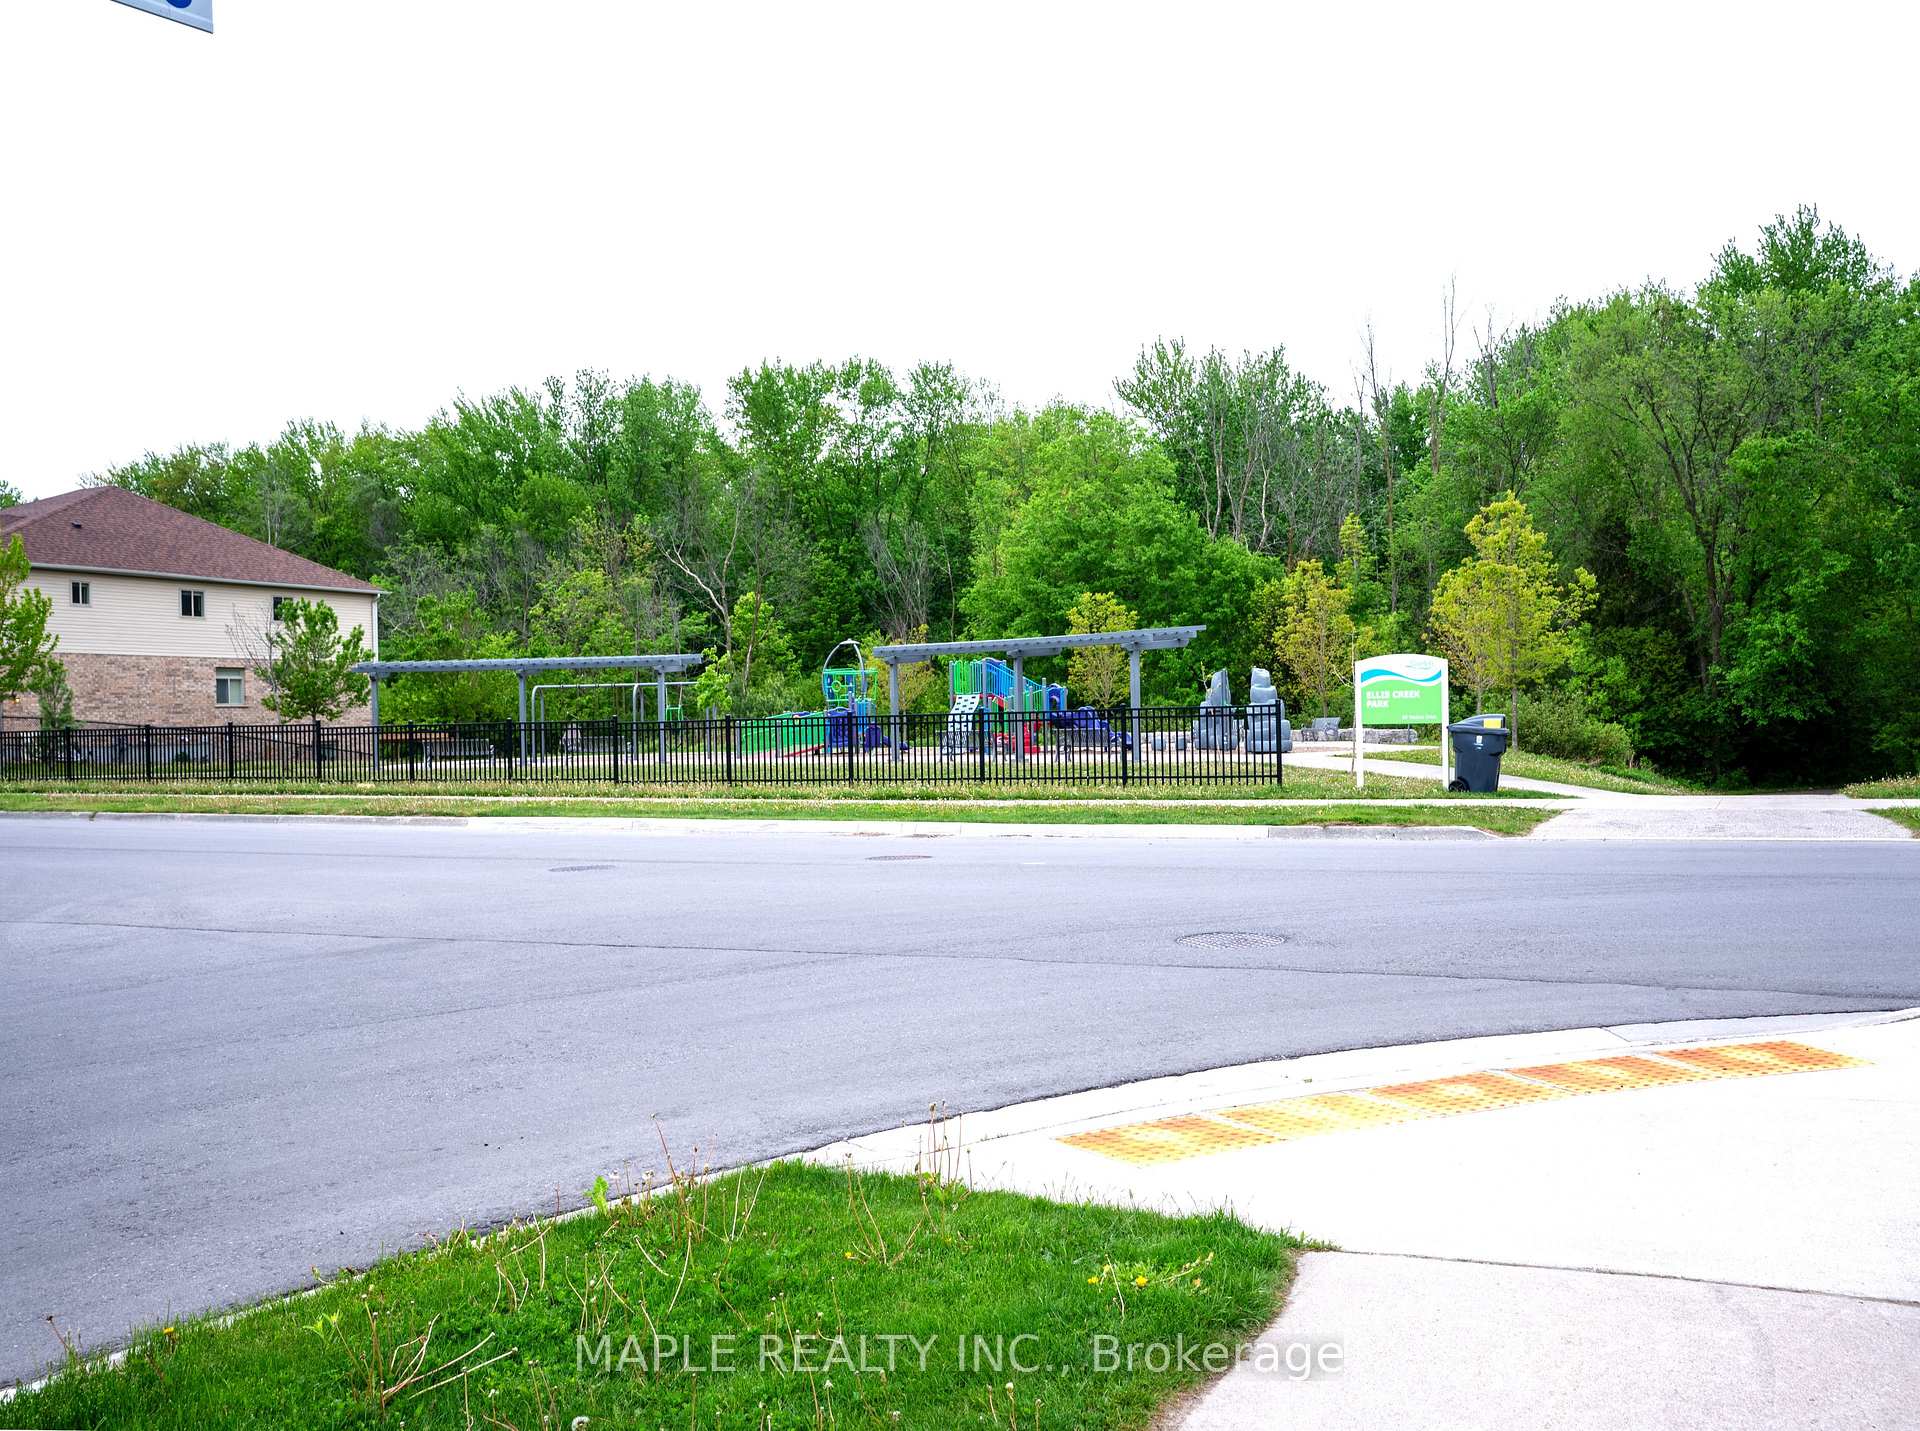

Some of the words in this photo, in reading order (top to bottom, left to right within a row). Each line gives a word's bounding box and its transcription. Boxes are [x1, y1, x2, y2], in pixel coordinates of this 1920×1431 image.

[1366, 690, 1390, 699] ELLIS
[1392, 689, 1421, 698] CREEK
[1366, 699, 1390, 708] PARK
